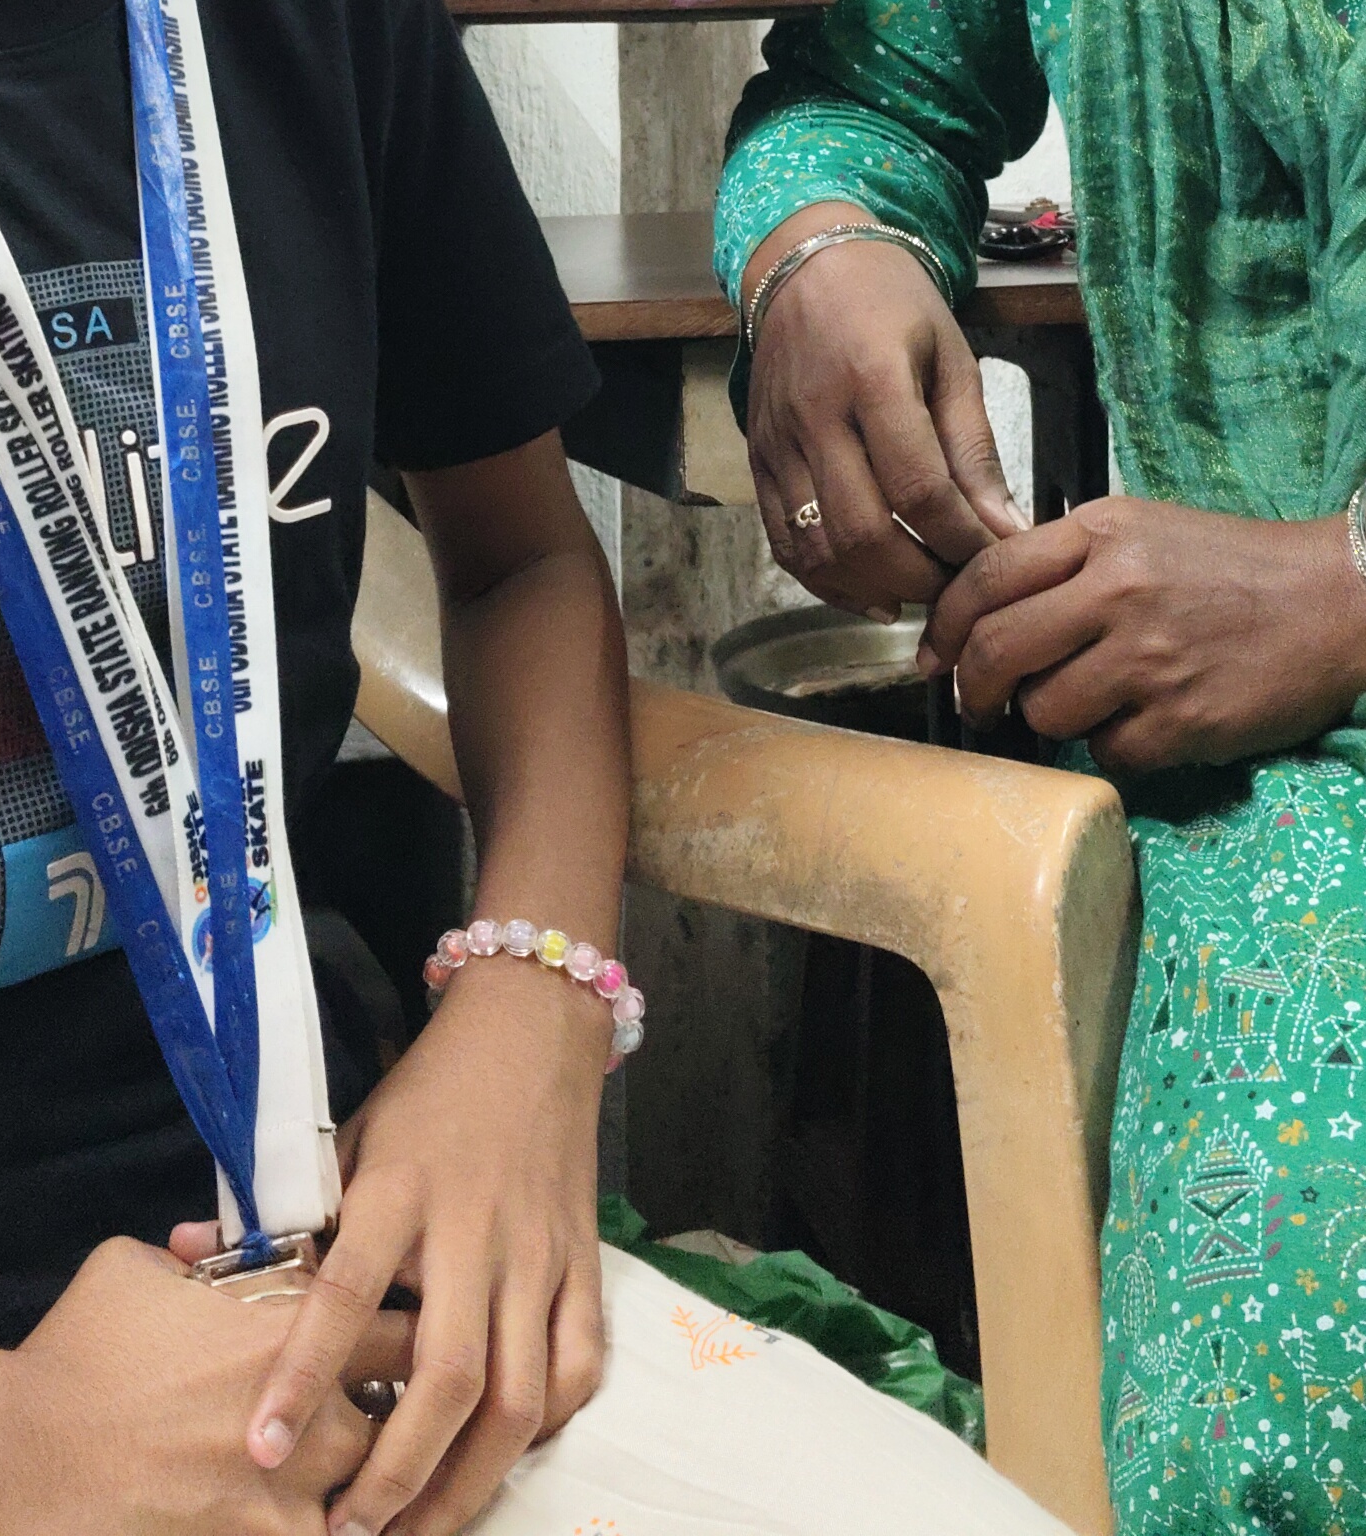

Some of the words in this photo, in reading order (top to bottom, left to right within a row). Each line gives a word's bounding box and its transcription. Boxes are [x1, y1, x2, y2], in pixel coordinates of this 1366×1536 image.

[5, 430, 70, 522] ROLLER
[26, 385, 75, 474] ROLLER
[38, 512, 111, 624] RANKING
[75, 606, 137, 695] STATE
[105, 683, 166, 781] ODISHA
[245, 758, 271, 870] SKATE
